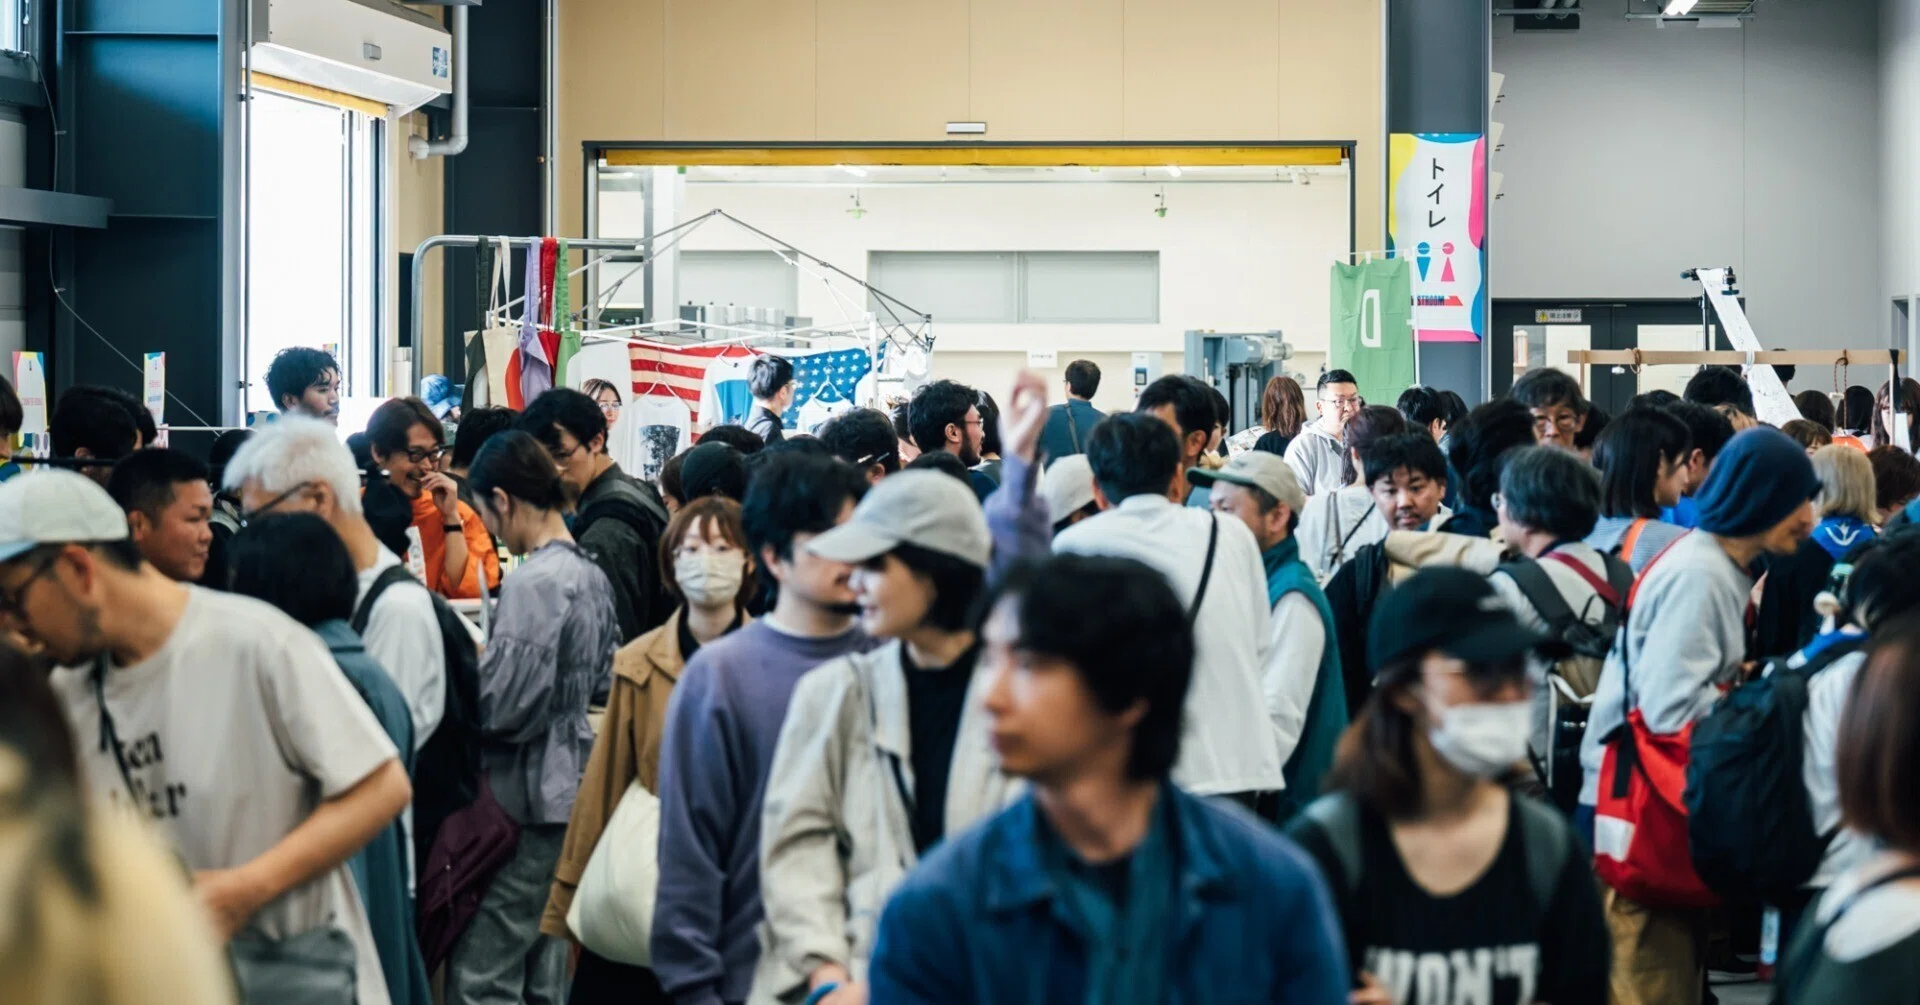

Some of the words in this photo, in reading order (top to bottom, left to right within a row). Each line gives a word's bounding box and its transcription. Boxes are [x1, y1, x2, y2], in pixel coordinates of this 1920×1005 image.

[1427, 157, 1446, 228] トイレ
[1411, 295, 1445, 306] STROOM
